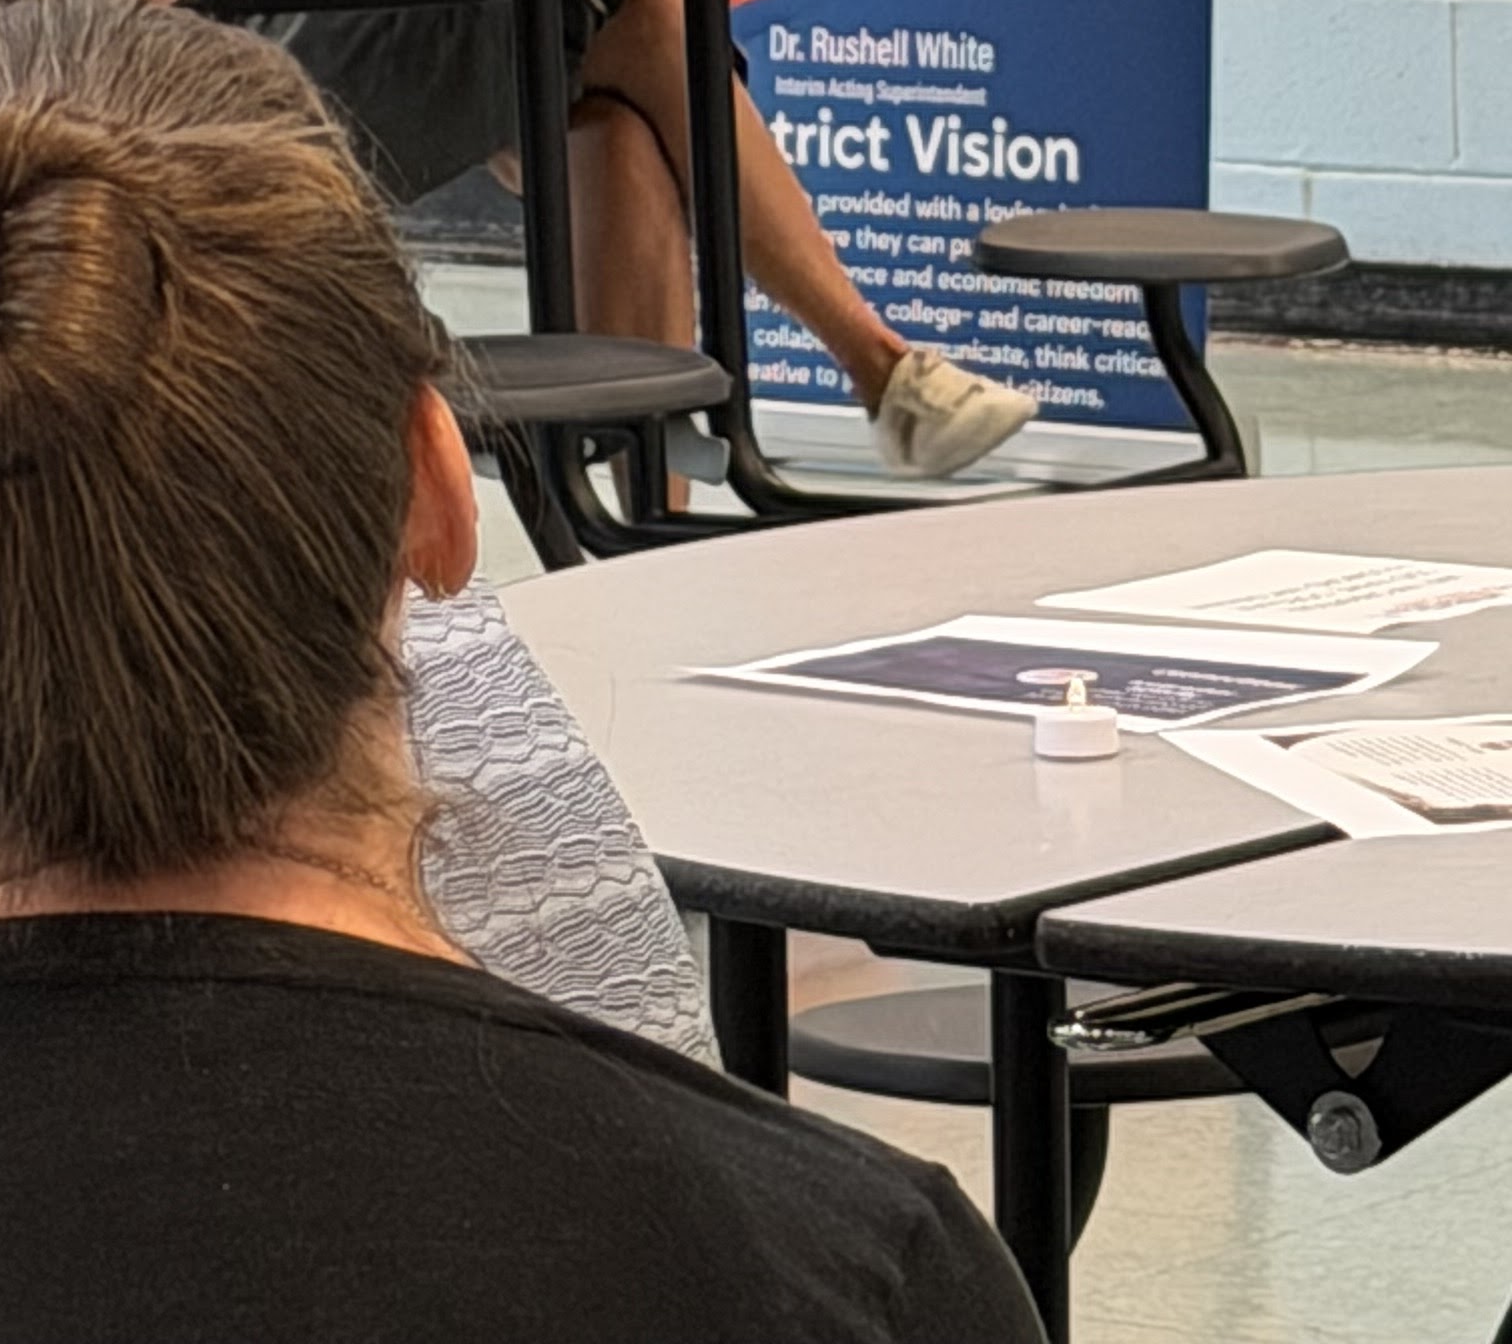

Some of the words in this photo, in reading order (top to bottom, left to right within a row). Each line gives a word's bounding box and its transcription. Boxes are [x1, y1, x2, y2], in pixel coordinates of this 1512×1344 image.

[769, 24, 805, 61] Dr.
[811, 26, 909, 67] Rushell
[916, 31, 994, 73] White
[775, 76, 826, 96] Interim
[828, 78, 873, 104] Acting
[876, 80, 987, 106] Superintendent
[769, 107, 891, 172] trict
[905, 114, 1079, 183] Vision
[818, 192, 910, 219] provided
[915, 195, 962, 221] with
[967, 201, 979, 221] a
[856, 226, 903, 257] they
[907, 236, 945, 254] can
[893, 266, 932, 290] and
[938, 273, 1041, 298] economic
[886, 300, 973, 330] college-
[979, 306, 1018, 330] and
[1035, 346, 1090, 372] think
[815, 366, 838, 387] to
